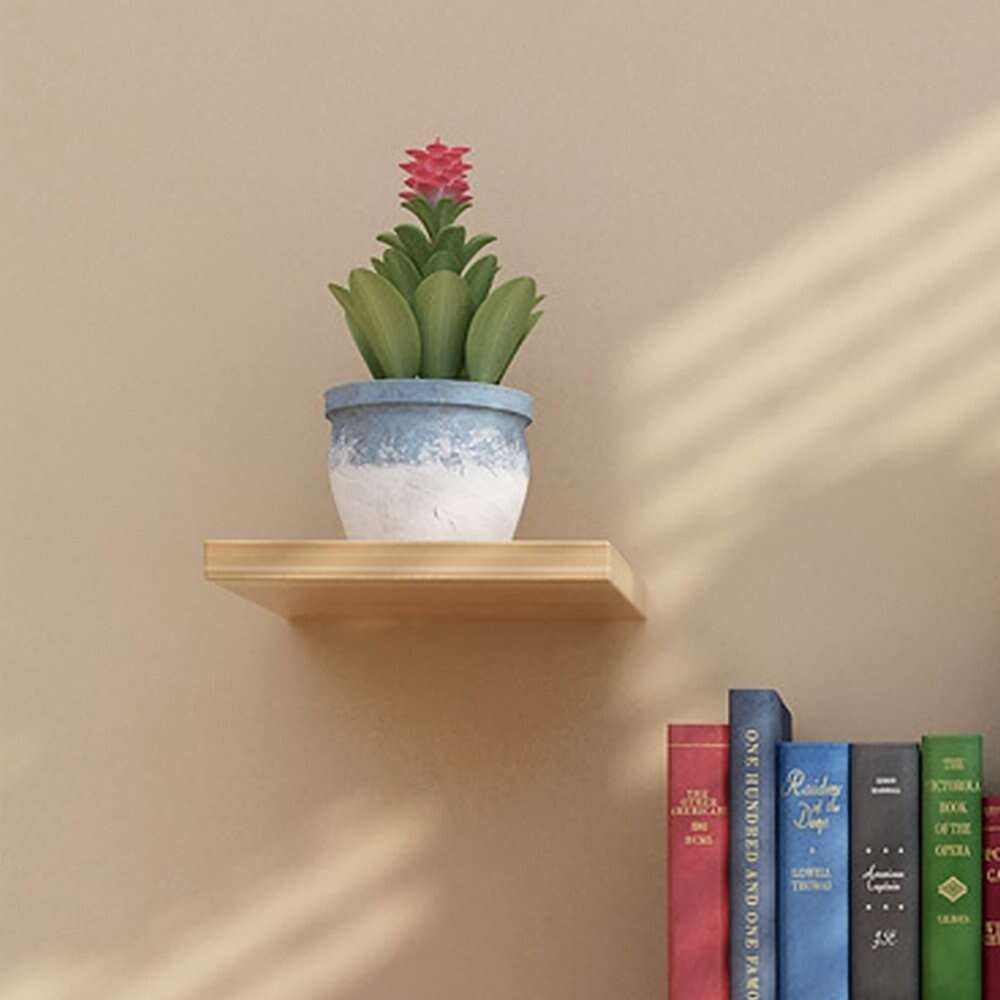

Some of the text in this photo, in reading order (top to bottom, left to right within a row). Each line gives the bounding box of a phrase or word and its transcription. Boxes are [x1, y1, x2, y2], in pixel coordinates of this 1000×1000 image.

[744, 729, 760, 767] ONE
[744, 772, 760, 863] HUNDRED
[939, 801, 968, 814] BOOK
[934, 844, 971, 857] OPERA
[744, 870, 760, 906] AND
[745, 911, 760, 949] ONE
